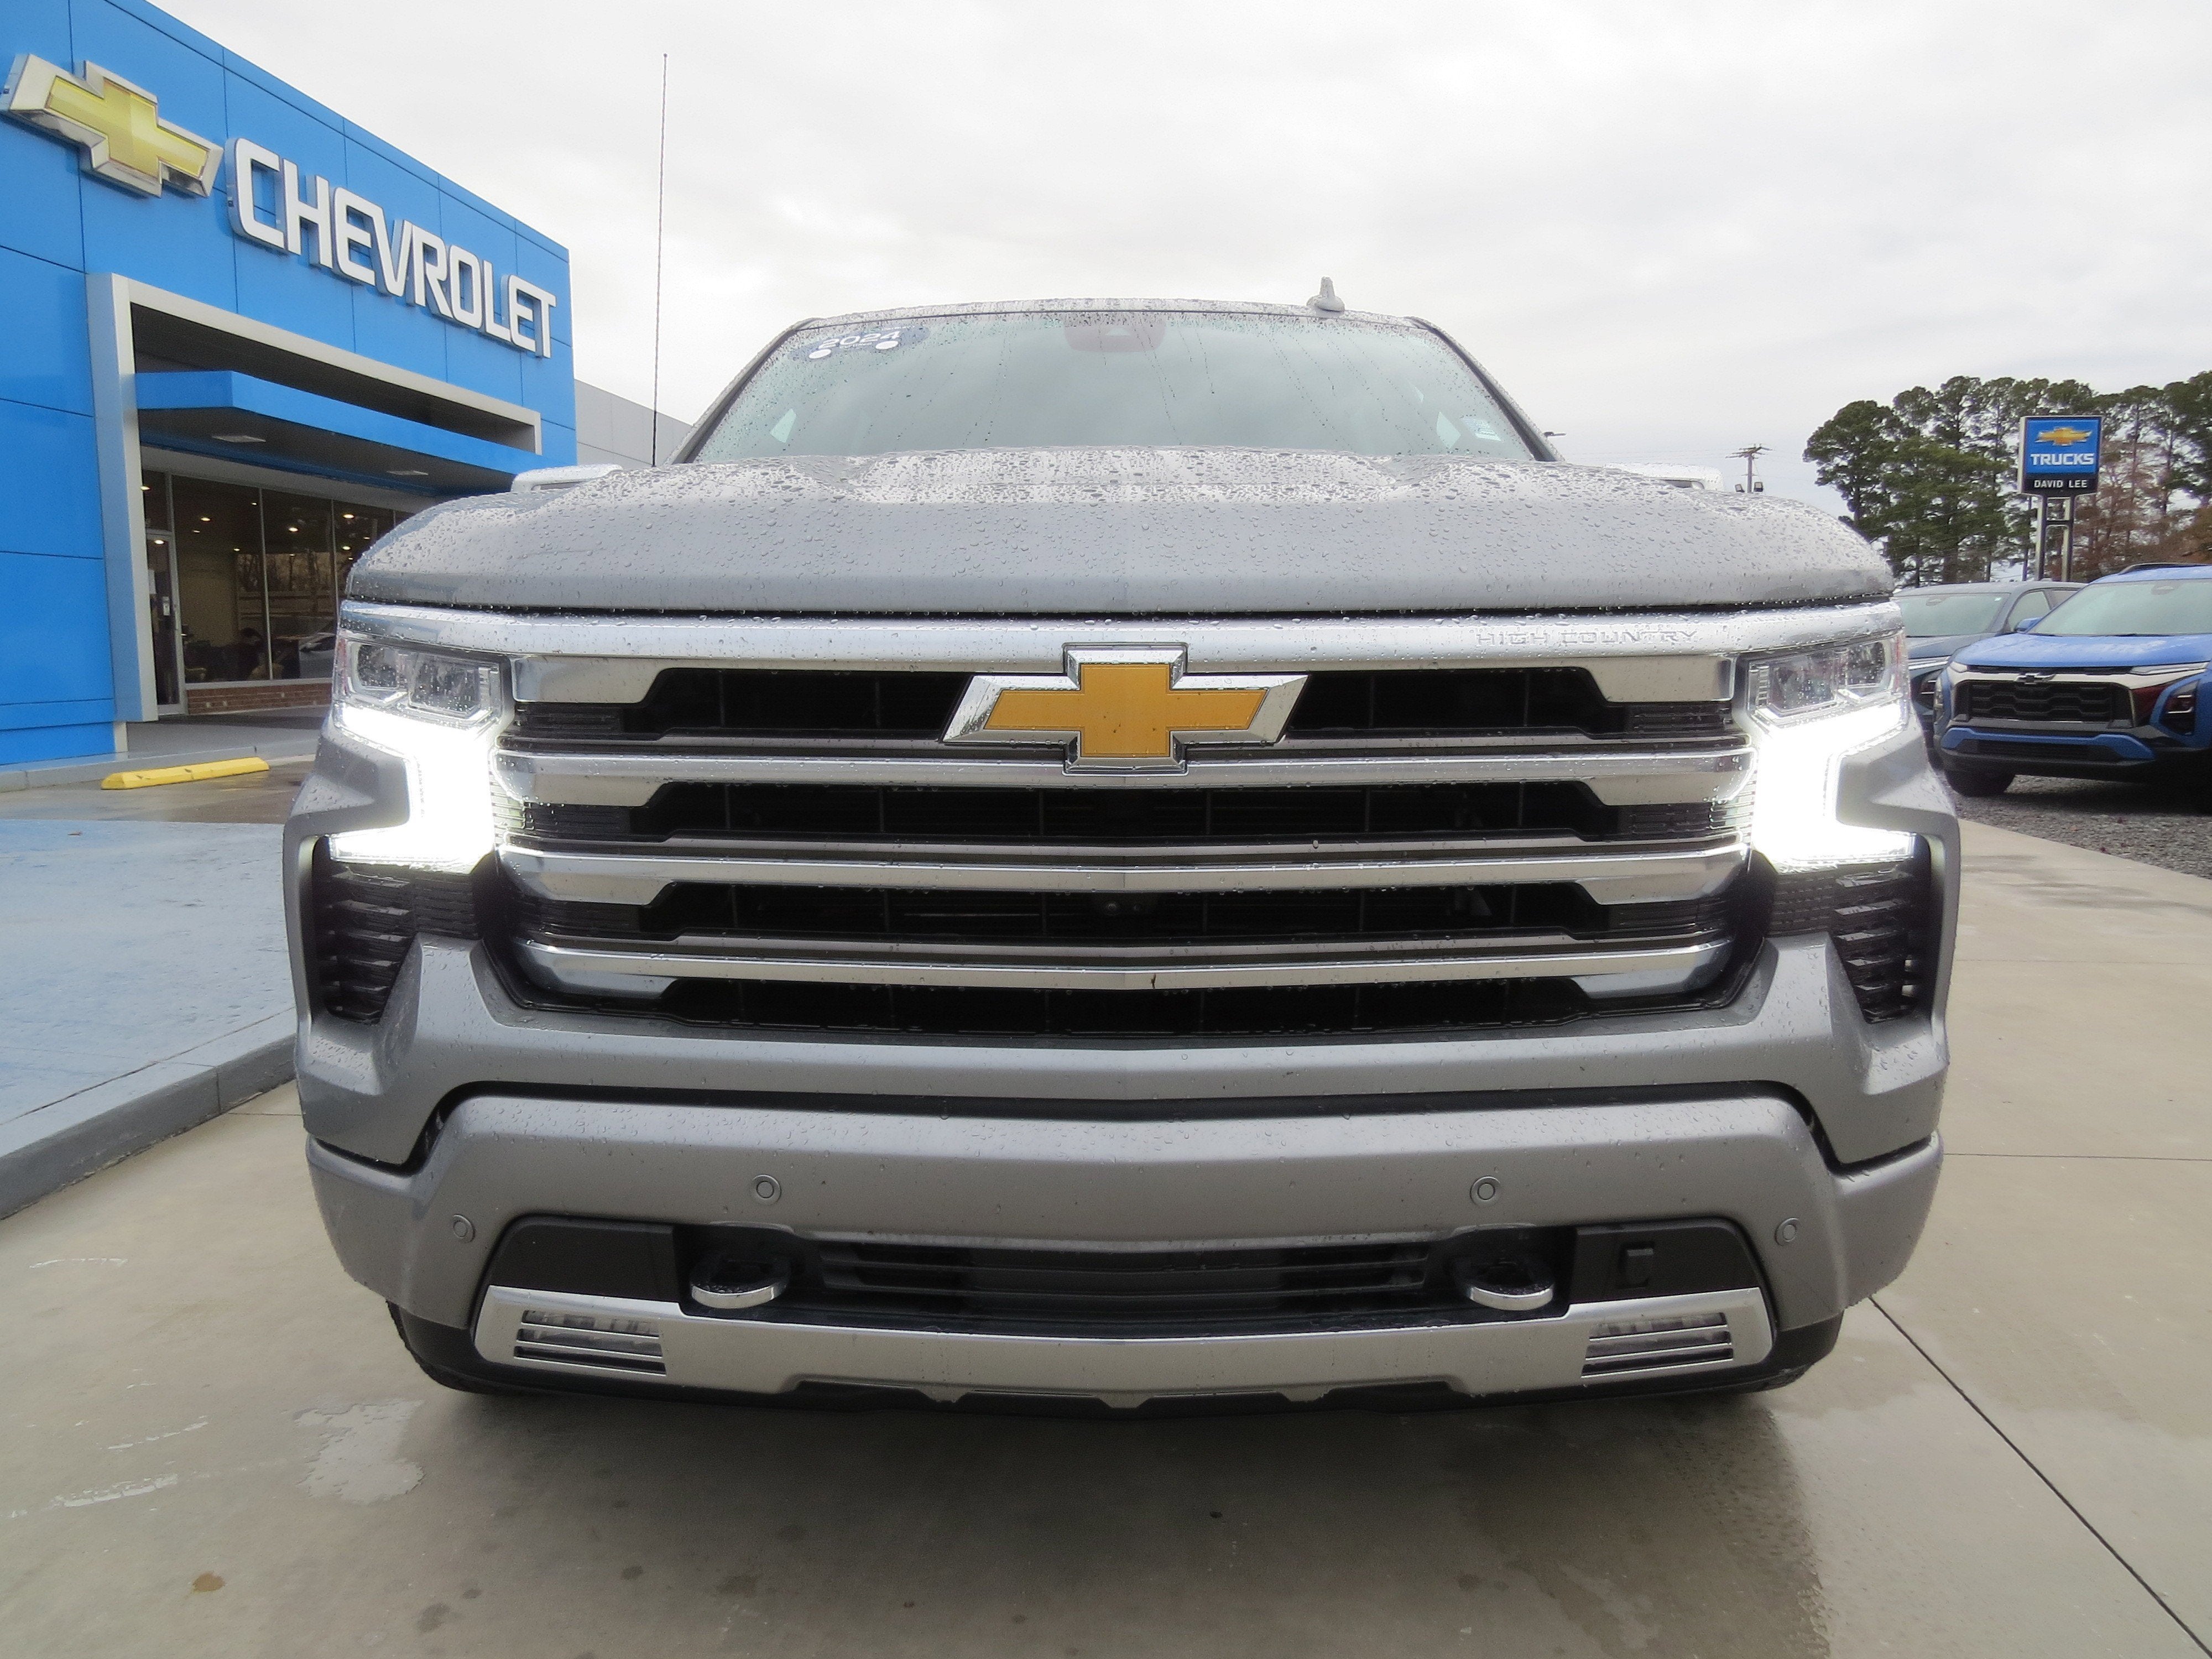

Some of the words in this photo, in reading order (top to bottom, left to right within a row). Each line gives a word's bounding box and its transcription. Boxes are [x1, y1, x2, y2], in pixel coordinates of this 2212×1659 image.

[227, 137, 556, 359] CHEVROLET
[818, 331, 900, 349] 2024
[2030, 453, 2094, 466] TRUCKS
[2034, 479, 2063, 488] DAVID
[2068, 479, 2088, 488] LEE
[1476, 632, 1548, 646] HIGH
[1560, 629, 1698, 645] COUNTRY
